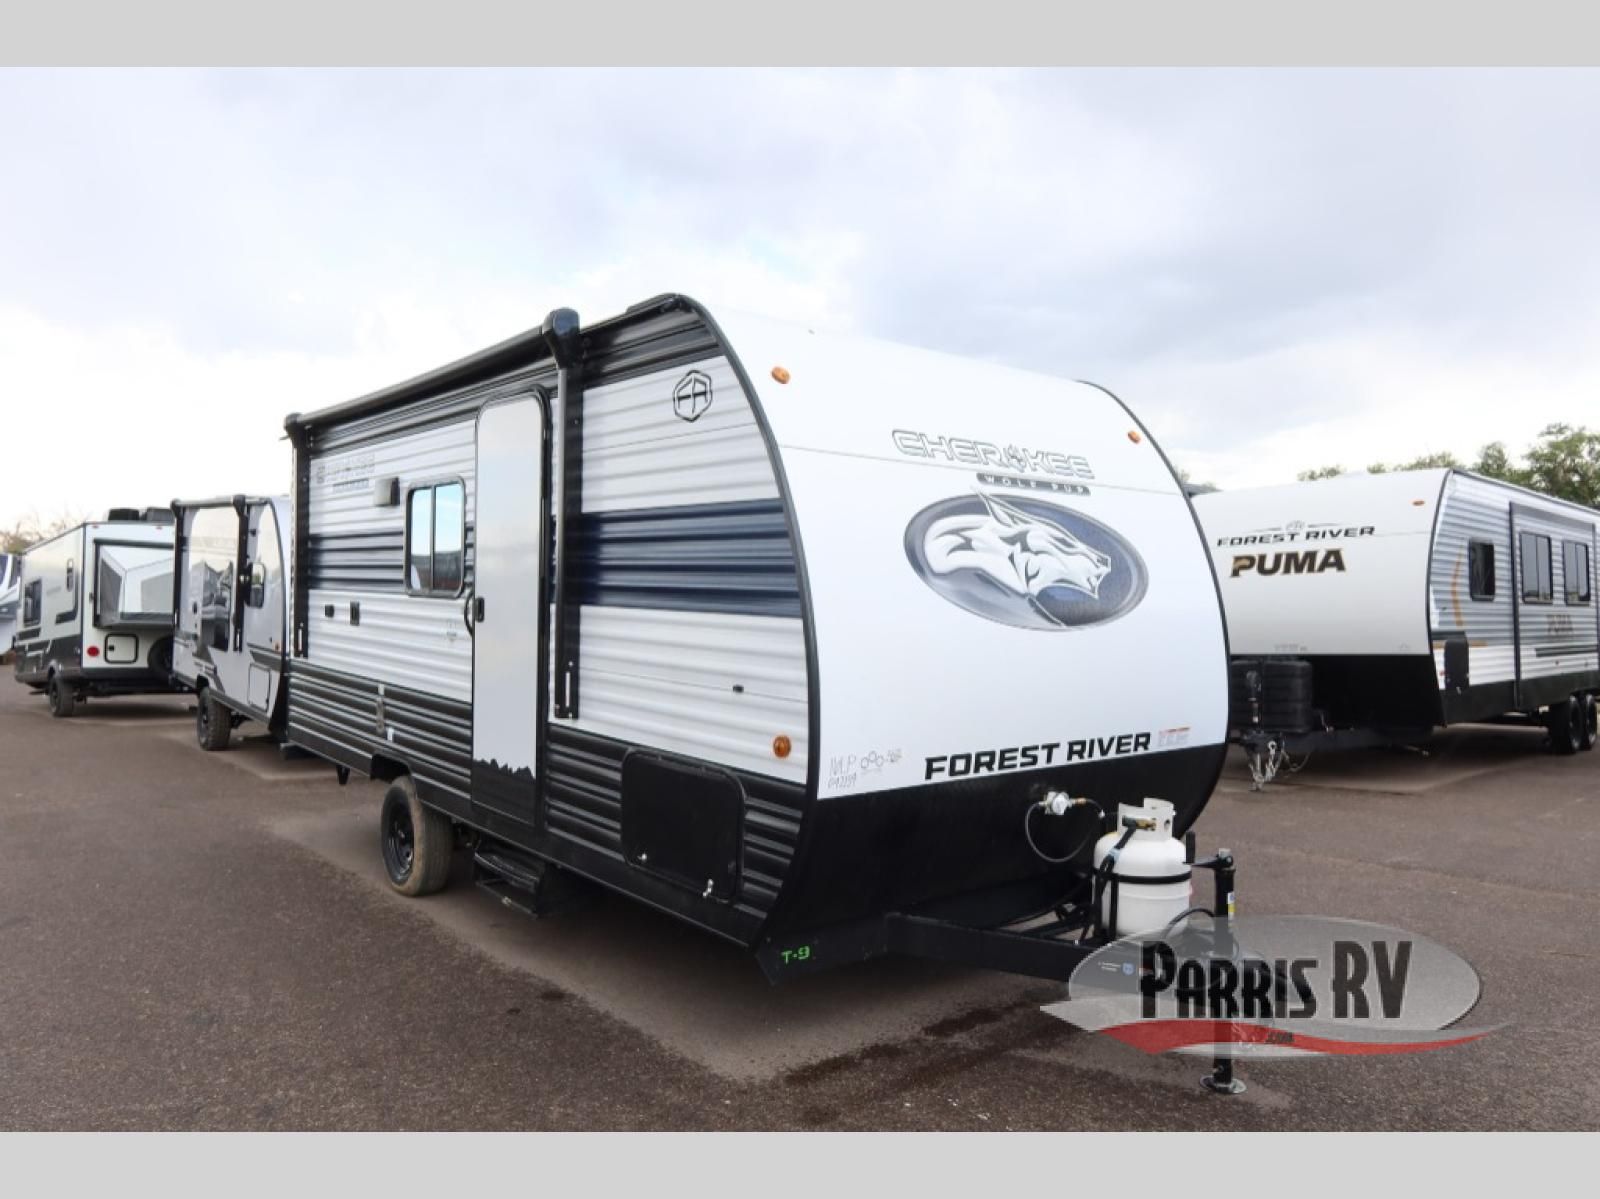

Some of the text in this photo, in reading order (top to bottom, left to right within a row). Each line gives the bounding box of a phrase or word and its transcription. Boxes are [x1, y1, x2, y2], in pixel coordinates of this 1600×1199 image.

[892, 430, 1095, 479] CHEROKEE
[1217, 525, 1375, 547] FOREST RIVER
[1230, 548, 1346, 578] PUMA
[925, 743, 1060, 780] FOREST
[1066, 732, 1151, 761] RIVER
[781, 945, 810, 964] T-9
